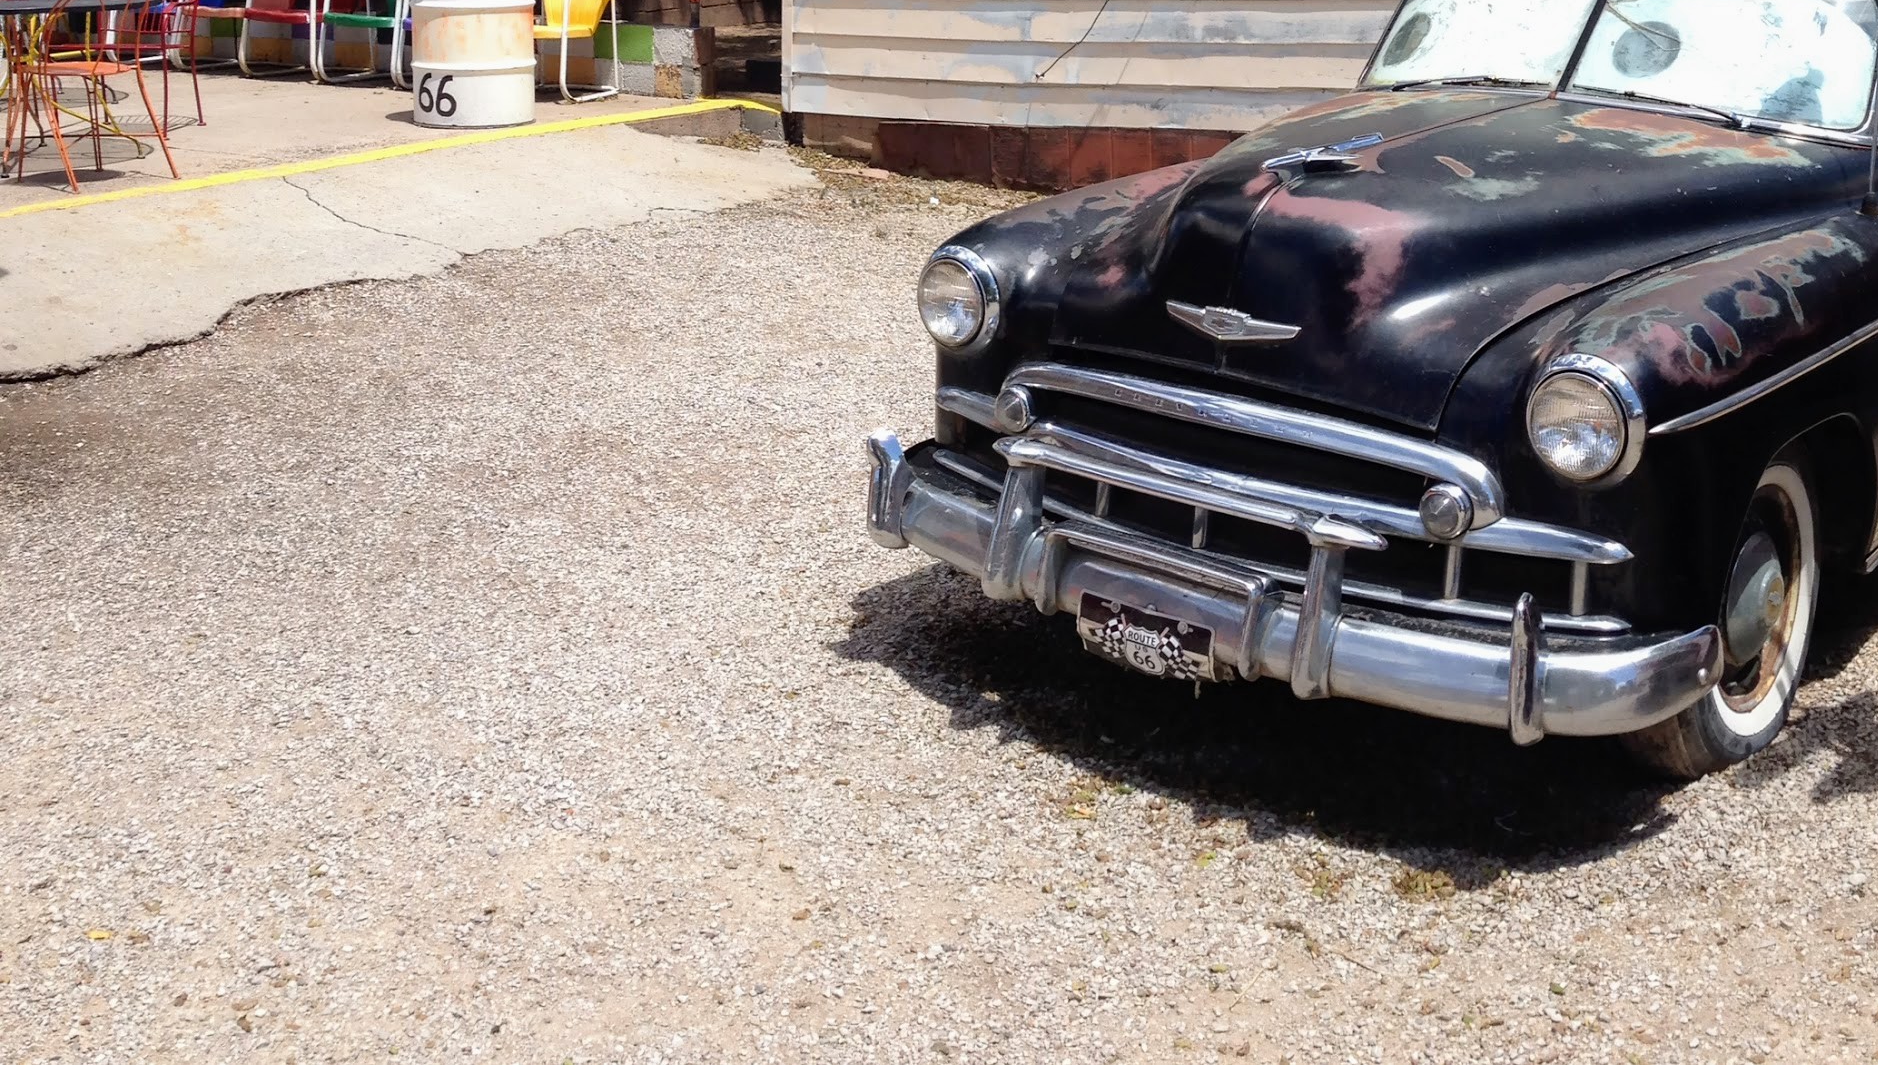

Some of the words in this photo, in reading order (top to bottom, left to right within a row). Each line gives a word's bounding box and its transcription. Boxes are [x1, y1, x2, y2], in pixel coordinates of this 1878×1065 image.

[417, 72, 458, 118] 66
[1127, 630, 1157, 647] ROUTE
[1134, 644, 1149, 653] US
[1132, 651, 1156, 670] 66
